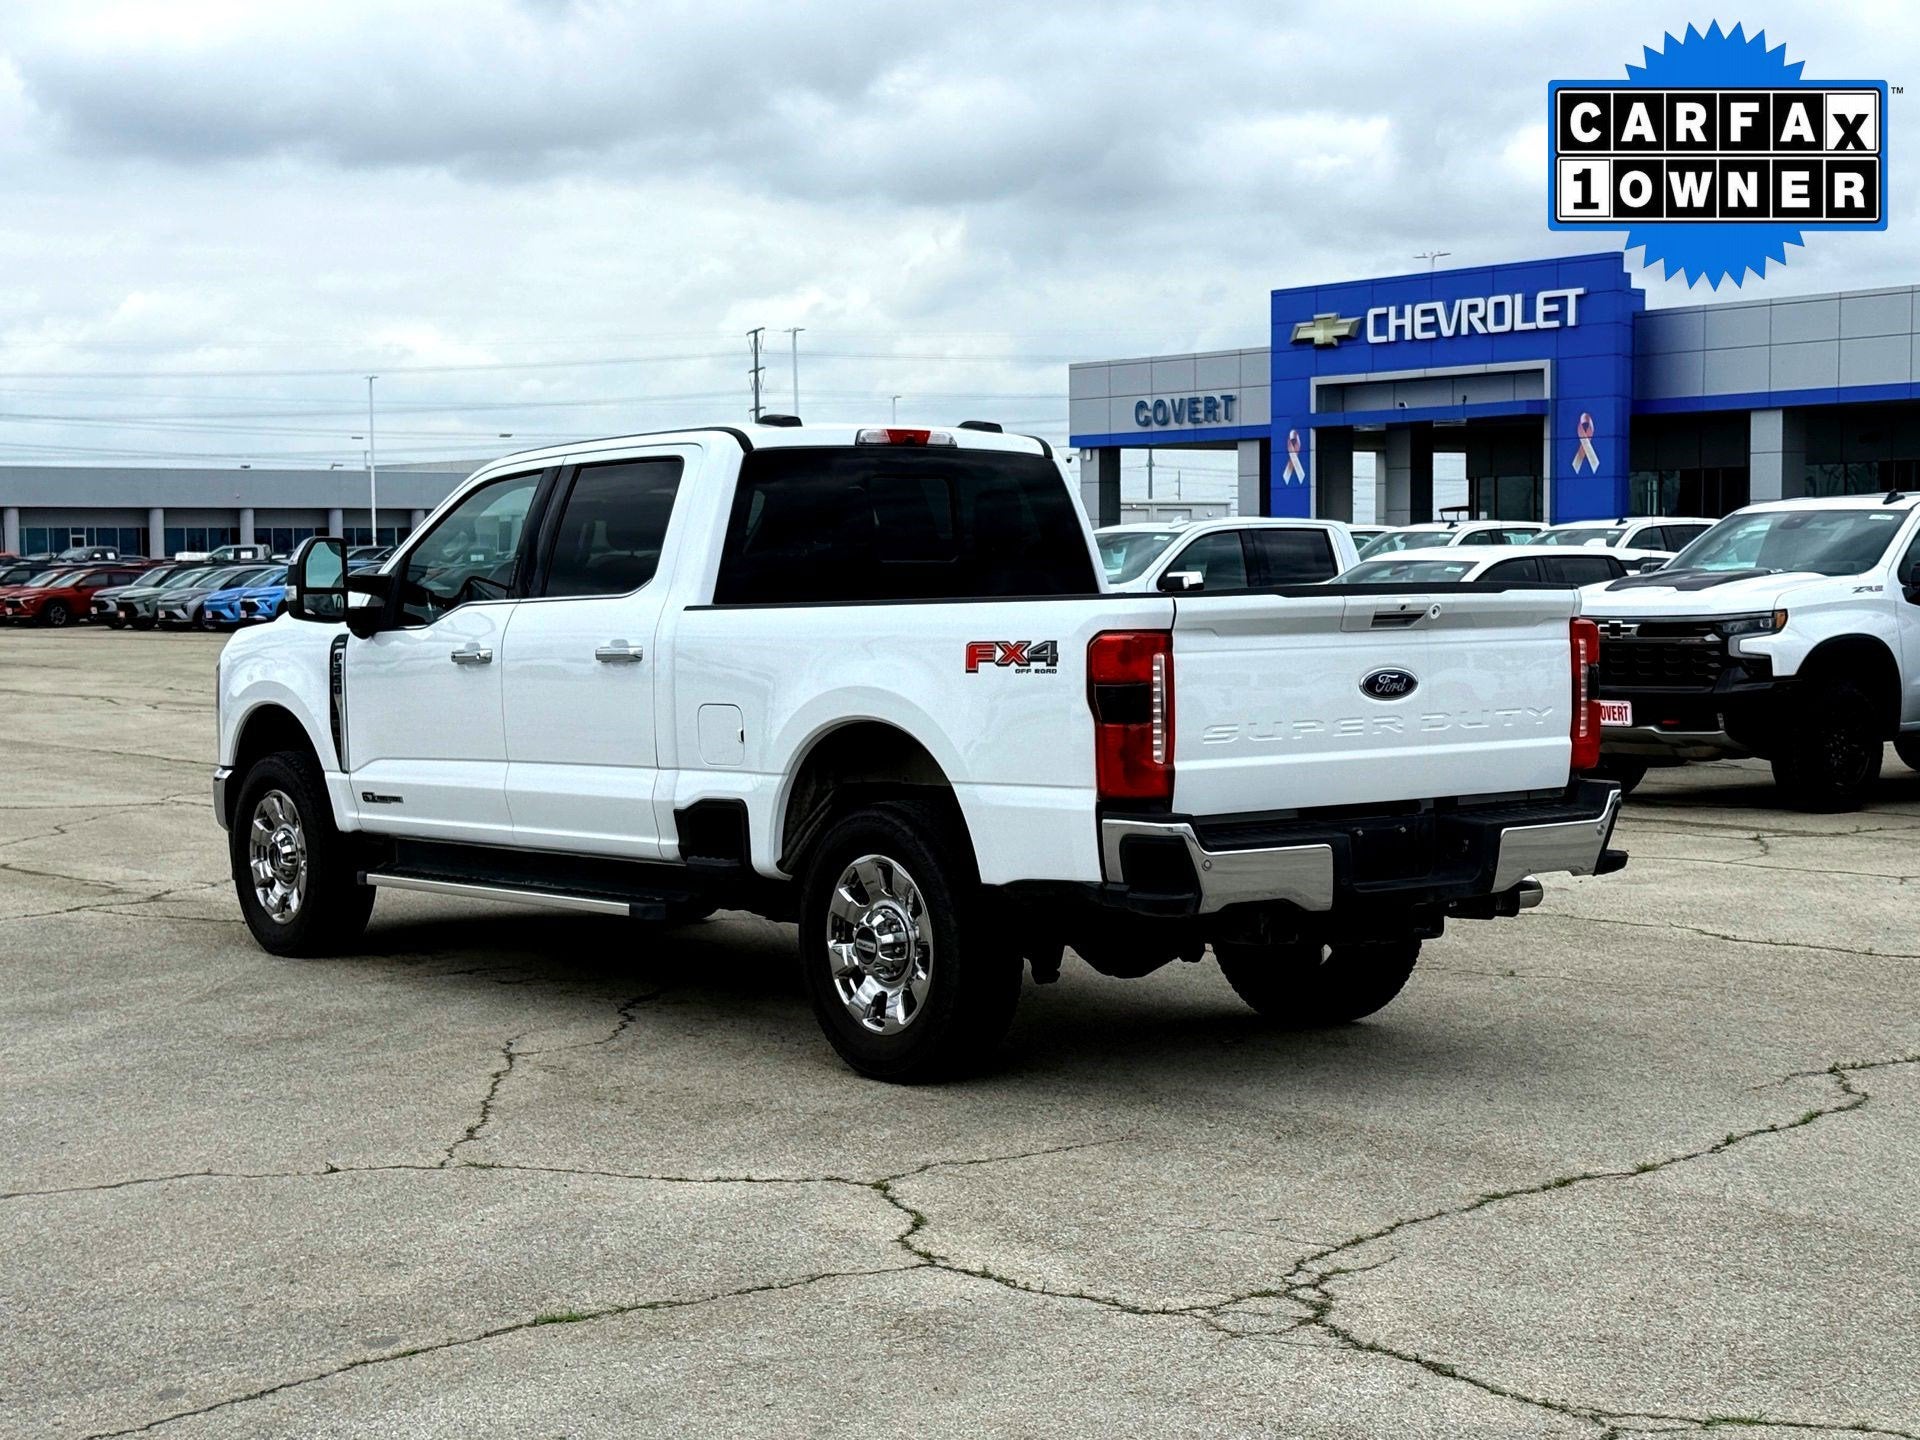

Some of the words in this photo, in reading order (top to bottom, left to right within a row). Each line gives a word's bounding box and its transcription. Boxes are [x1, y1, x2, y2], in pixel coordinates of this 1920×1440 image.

[1366, 287, 1587, 344] CHEVROLET
[1134, 394, 1236, 427] COVERT
[965, 640, 1059, 673] FX4
[1375, 673, 1408, 693] Ford
[1203, 715, 1404, 744] SUPER
[1421, 706, 1553, 731] DUTY
[1600, 705, 1629, 721] OVERT
